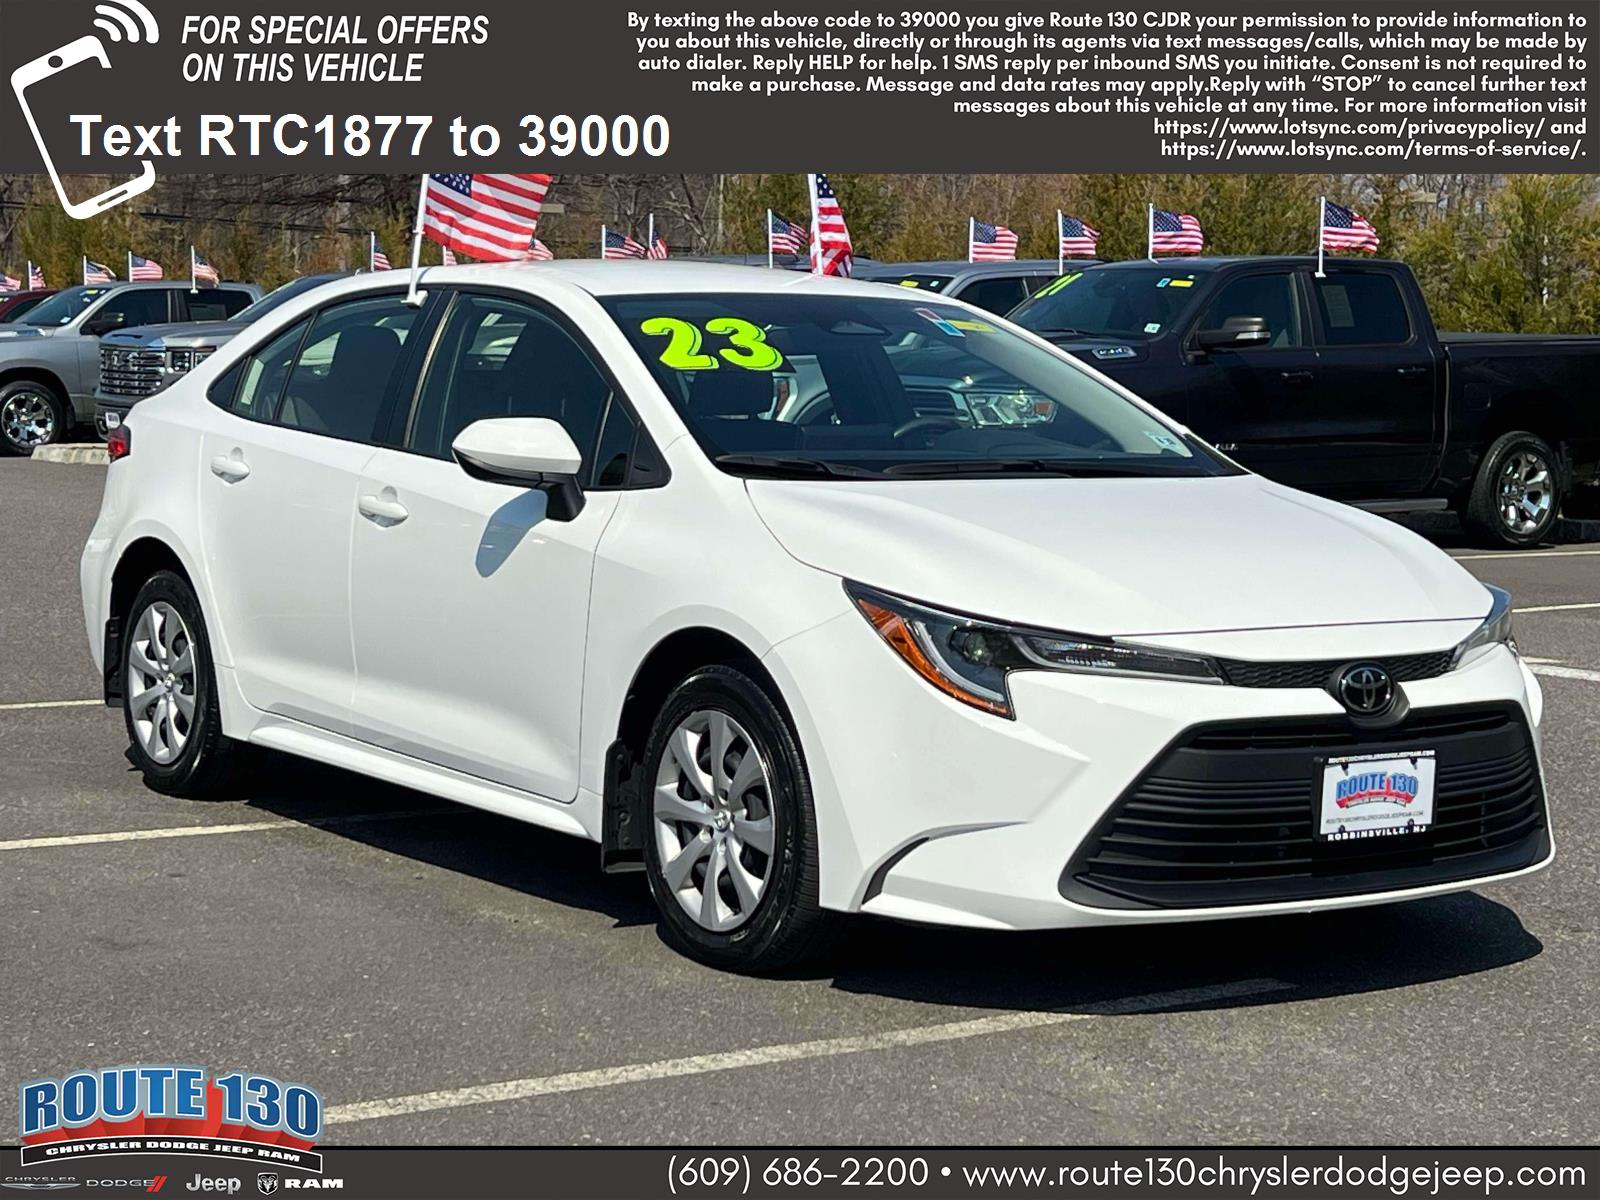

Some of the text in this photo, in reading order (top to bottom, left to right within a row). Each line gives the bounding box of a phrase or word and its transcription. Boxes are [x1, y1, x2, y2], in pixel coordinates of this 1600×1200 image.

[641, 317, 784, 371] 23
[1336, 771, 1418, 800] ROUTE 130
[1327, 825, 1427, 841] ROBBINSVILLE, NJ
